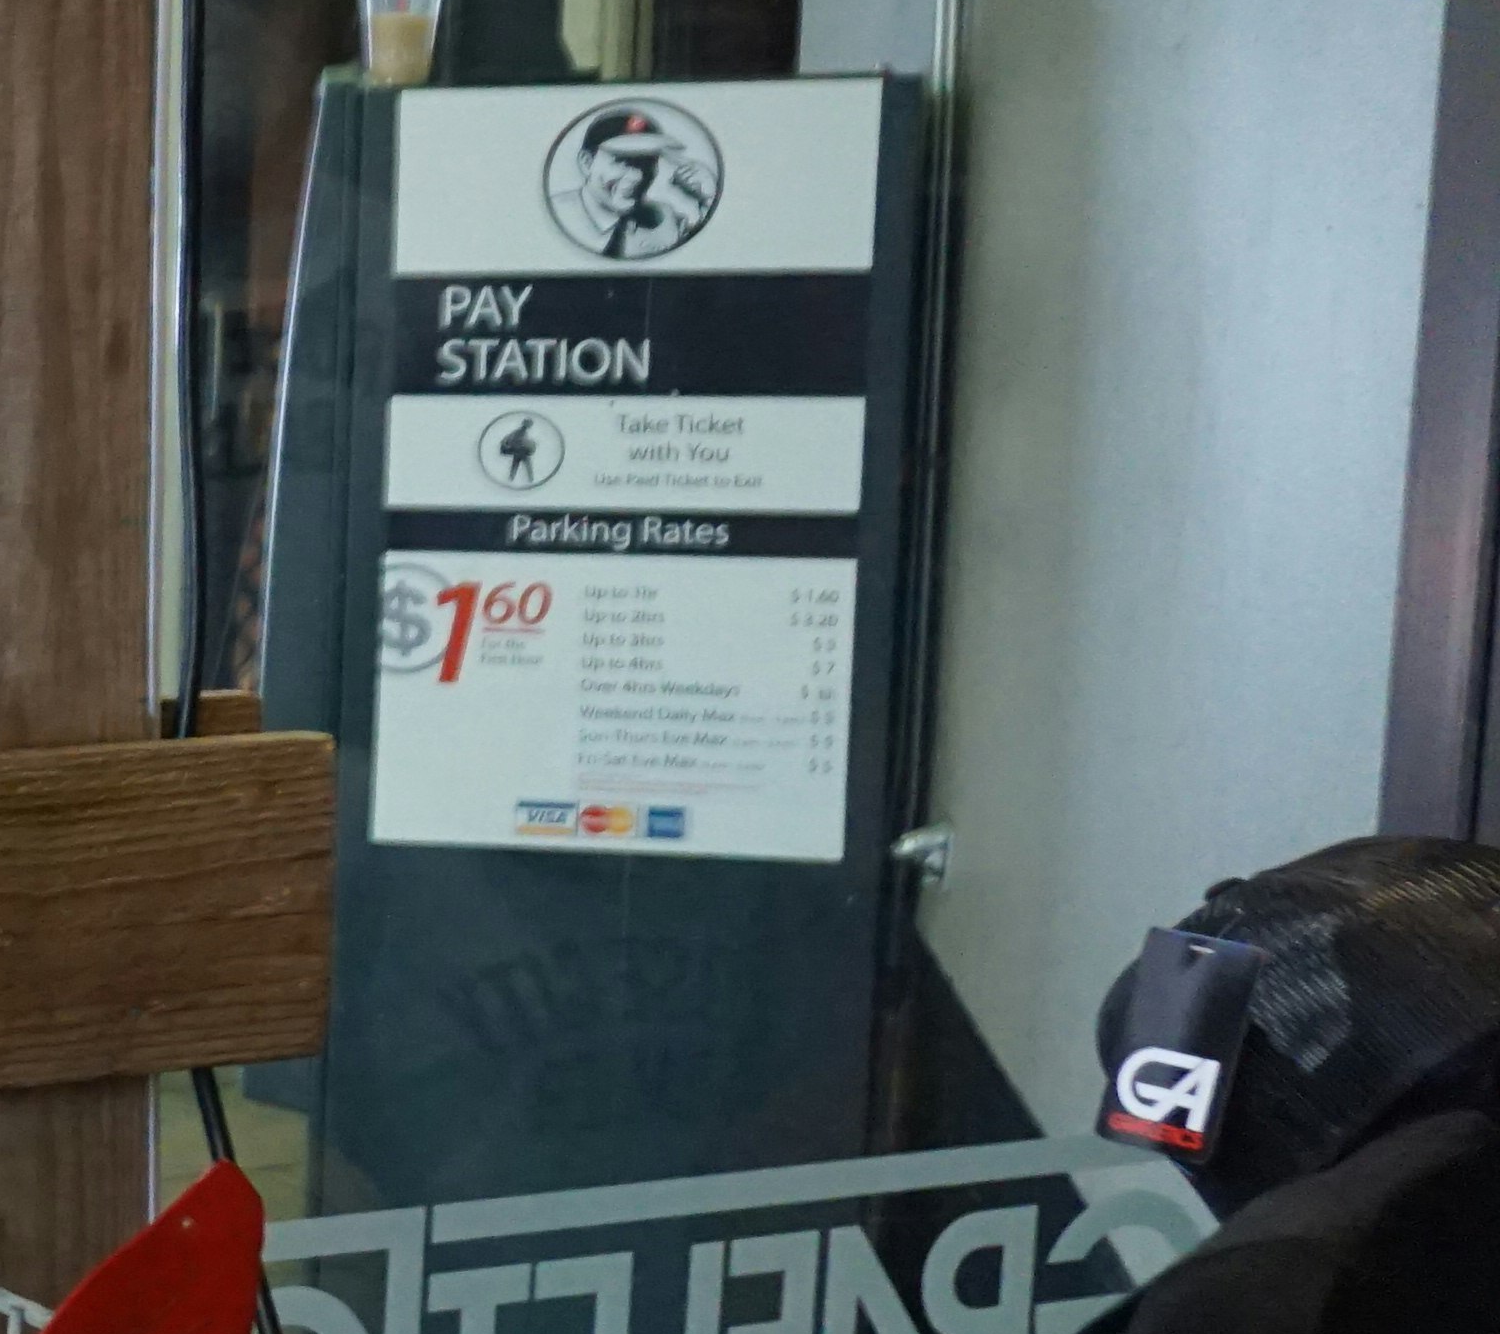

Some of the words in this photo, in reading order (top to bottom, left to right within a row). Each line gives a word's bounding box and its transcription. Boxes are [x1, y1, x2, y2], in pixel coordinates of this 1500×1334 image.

[438, 284, 533, 330] PAY
[436, 337, 651, 385] STATION
[619, 413, 669, 434] Take
[676, 413, 745, 435] Ticket
[629, 443, 680, 462] with
[687, 443, 731, 462] You
[509, 513, 631, 548] Parking
[642, 515, 730, 545] Rates
[526, 806, 568, 824] VISA
